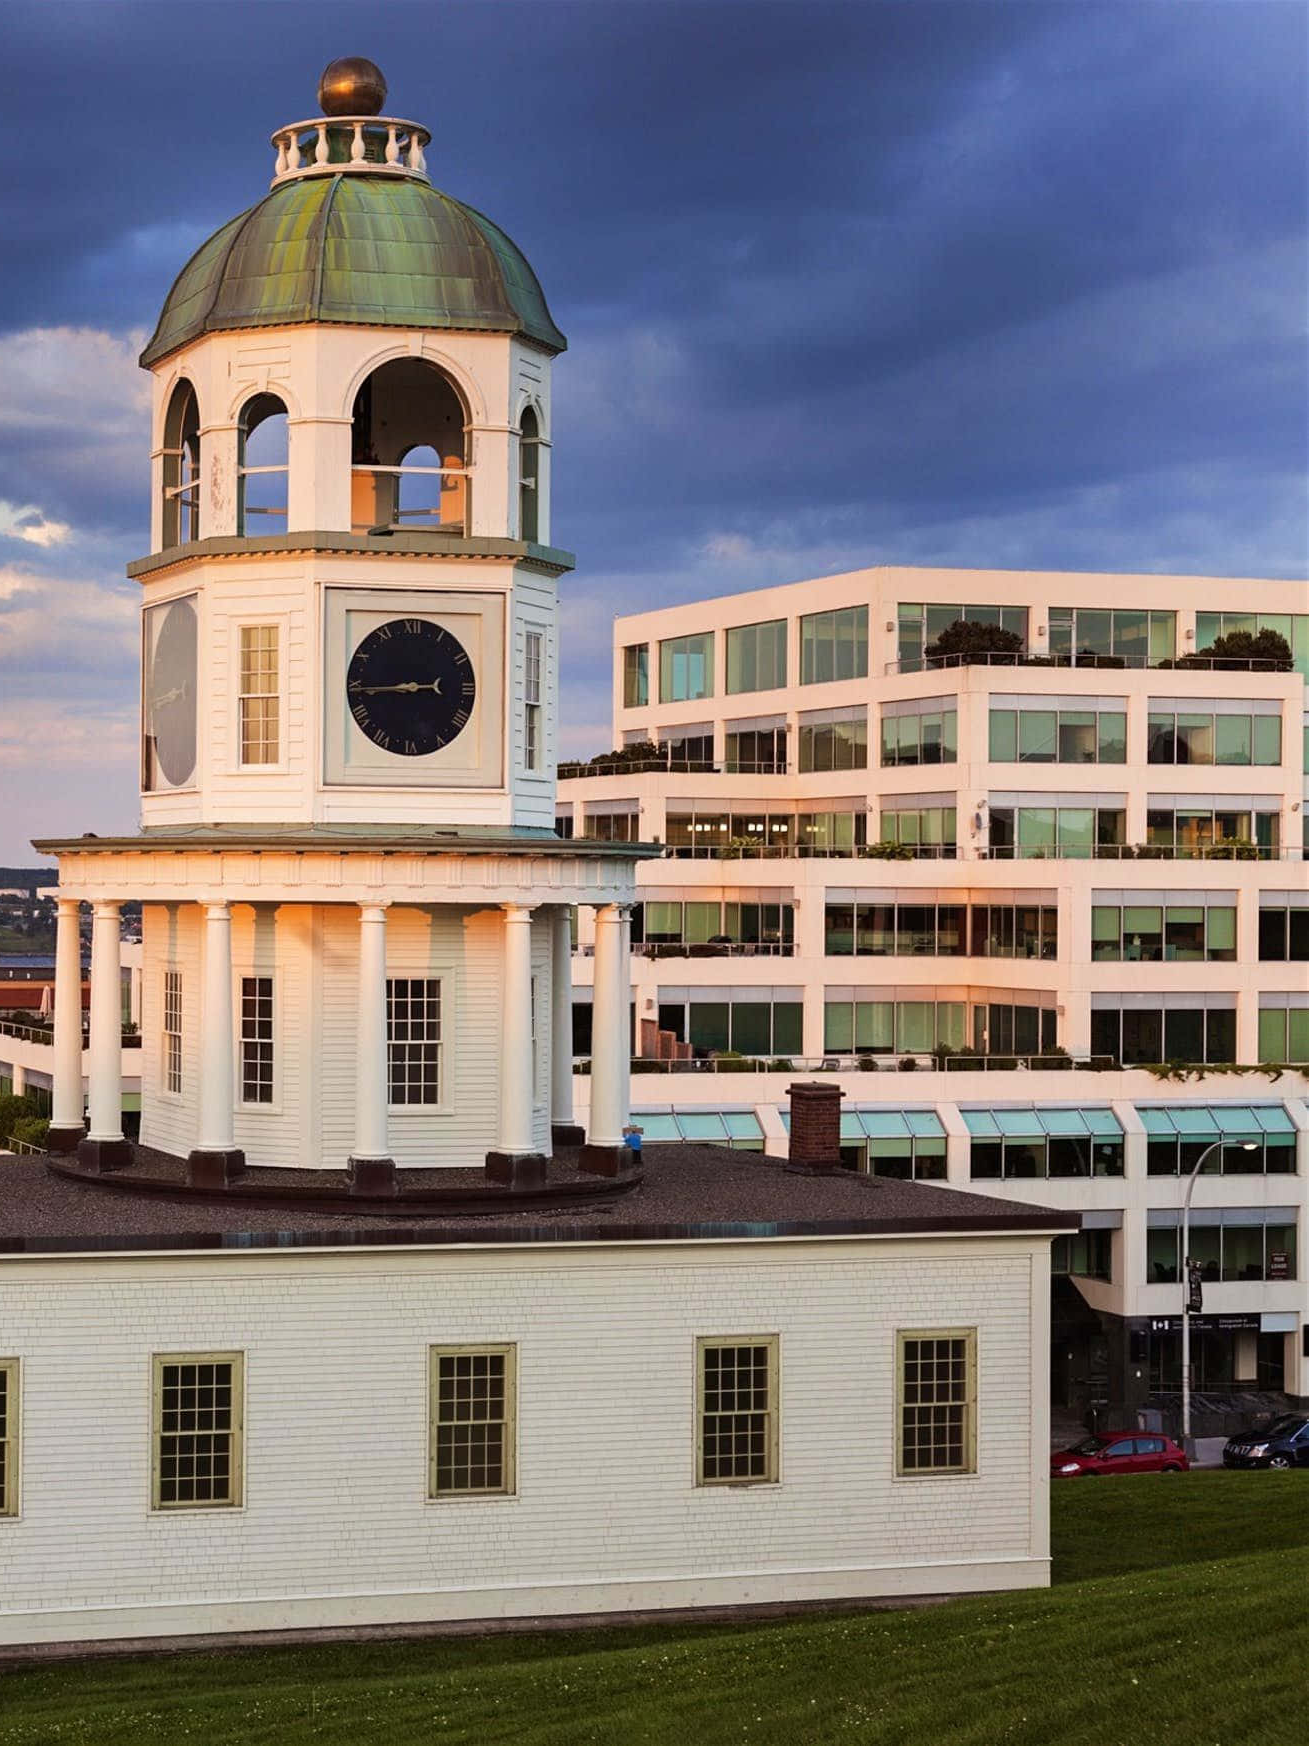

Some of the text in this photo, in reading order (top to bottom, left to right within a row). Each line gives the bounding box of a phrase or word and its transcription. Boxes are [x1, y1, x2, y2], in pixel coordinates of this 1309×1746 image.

[377, 626, 392, 640] XI
[404, 620, 422, 634] XII
[355, 650, 370, 663] X
[454, 652, 467, 665] II
[461, 682, 474, 695] III
[374, 729, 390, 749] VII
[405, 740, 418, 754] VI
